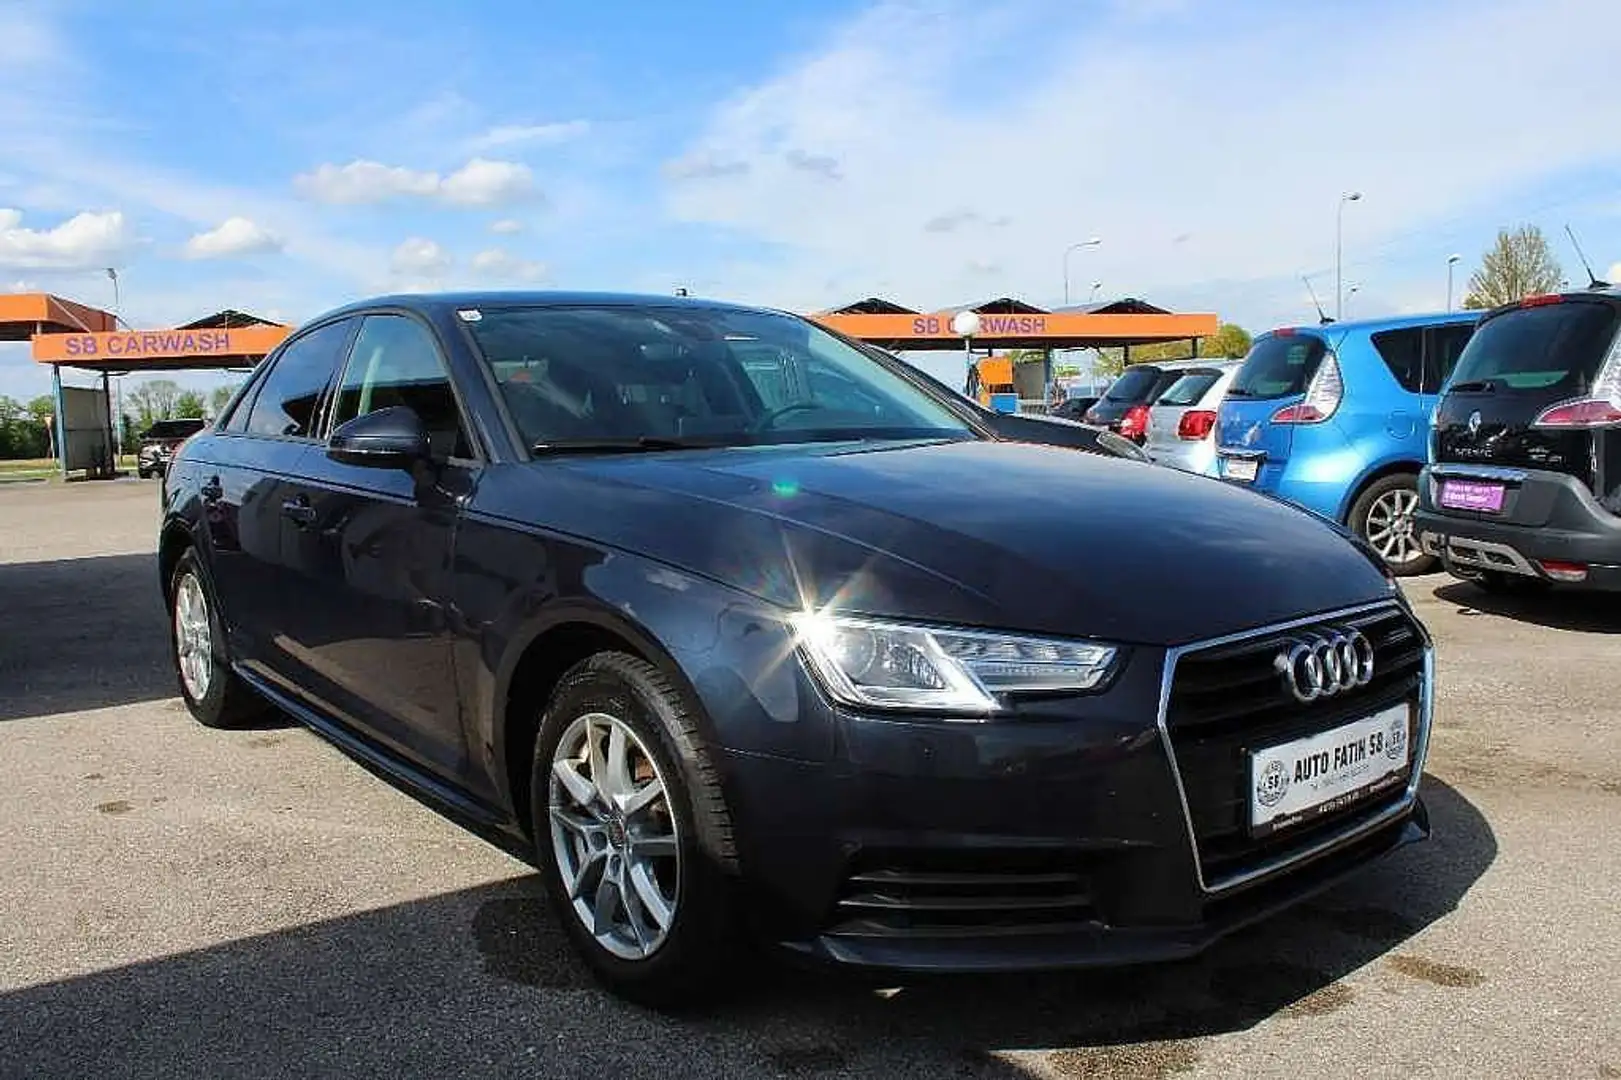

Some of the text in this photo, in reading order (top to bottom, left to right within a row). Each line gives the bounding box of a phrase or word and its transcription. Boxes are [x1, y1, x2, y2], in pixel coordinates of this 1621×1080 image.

[912, 317, 940, 334] SB
[65, 332, 229, 355] SB CARWASH
[1294, 751, 1329, 783] AUTO
[1333, 737, 1366, 770] FATIH
